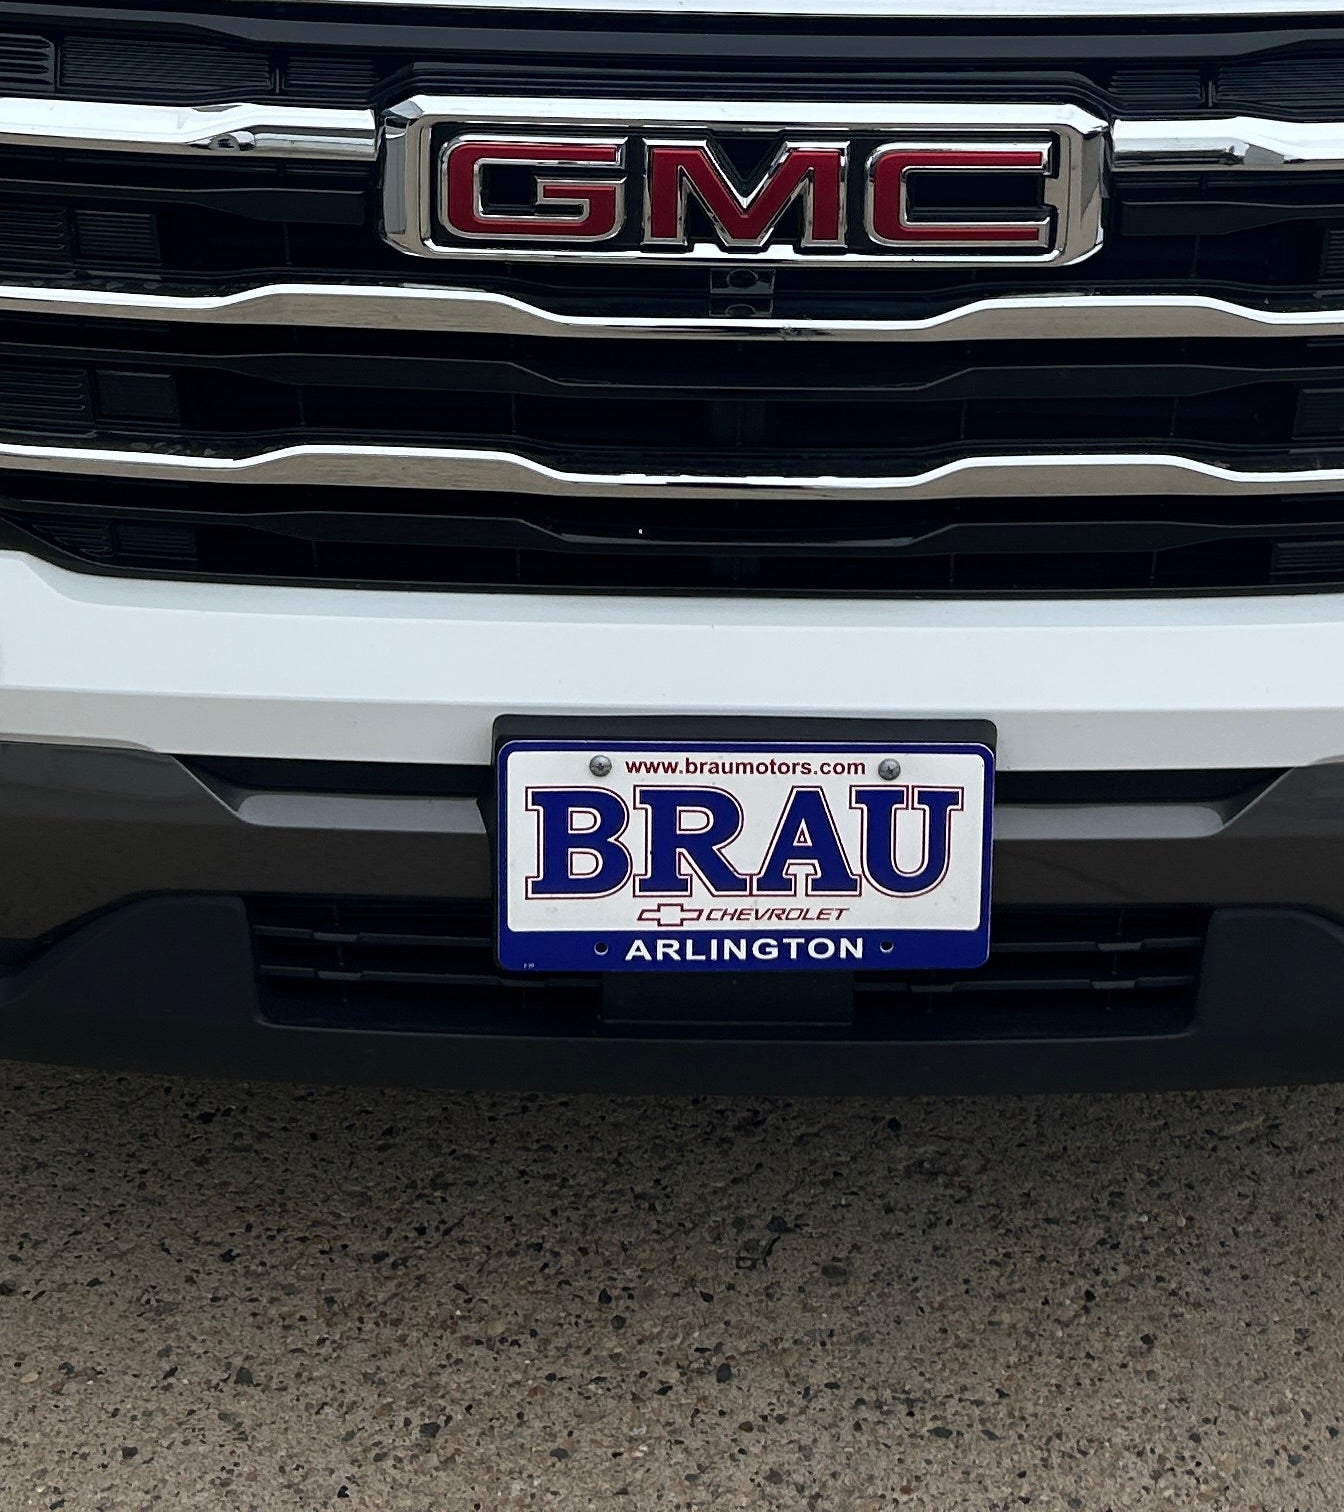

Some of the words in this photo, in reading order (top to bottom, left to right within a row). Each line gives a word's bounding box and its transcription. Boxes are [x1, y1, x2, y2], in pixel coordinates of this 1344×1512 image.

[438, 134, 1052, 249] GMC
[625, 756, 866, 777] www.braumotors.com
[525, 785, 964, 900] BRAU
[706, 907, 850, 922] CHEVROLET
[624, 937, 864, 961] ARLINGTON
